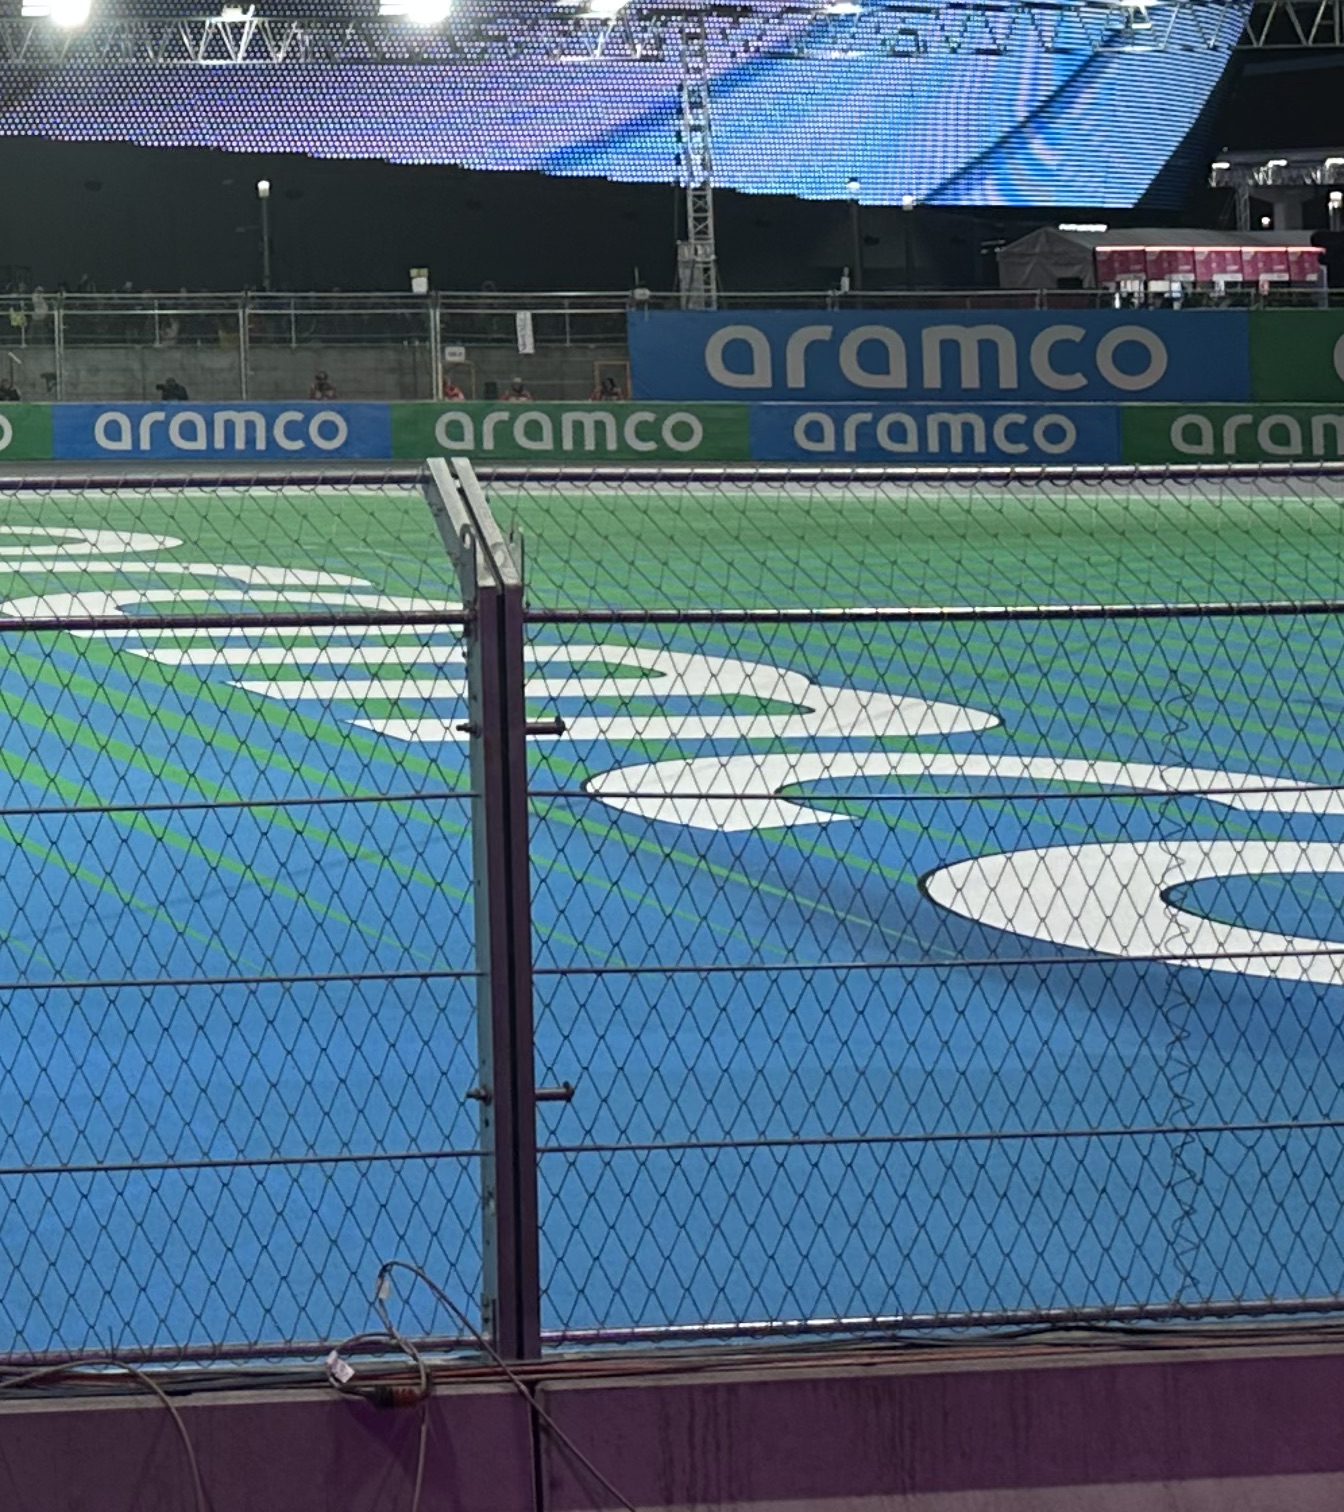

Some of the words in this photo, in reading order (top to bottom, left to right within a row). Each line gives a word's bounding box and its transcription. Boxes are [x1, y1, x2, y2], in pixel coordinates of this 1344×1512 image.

[704, 324, 1168, 391] aramco
[94, 410, 348, 451] aramco
[434, 410, 703, 452] aramco
[793, 411, 1077, 454] aramco
